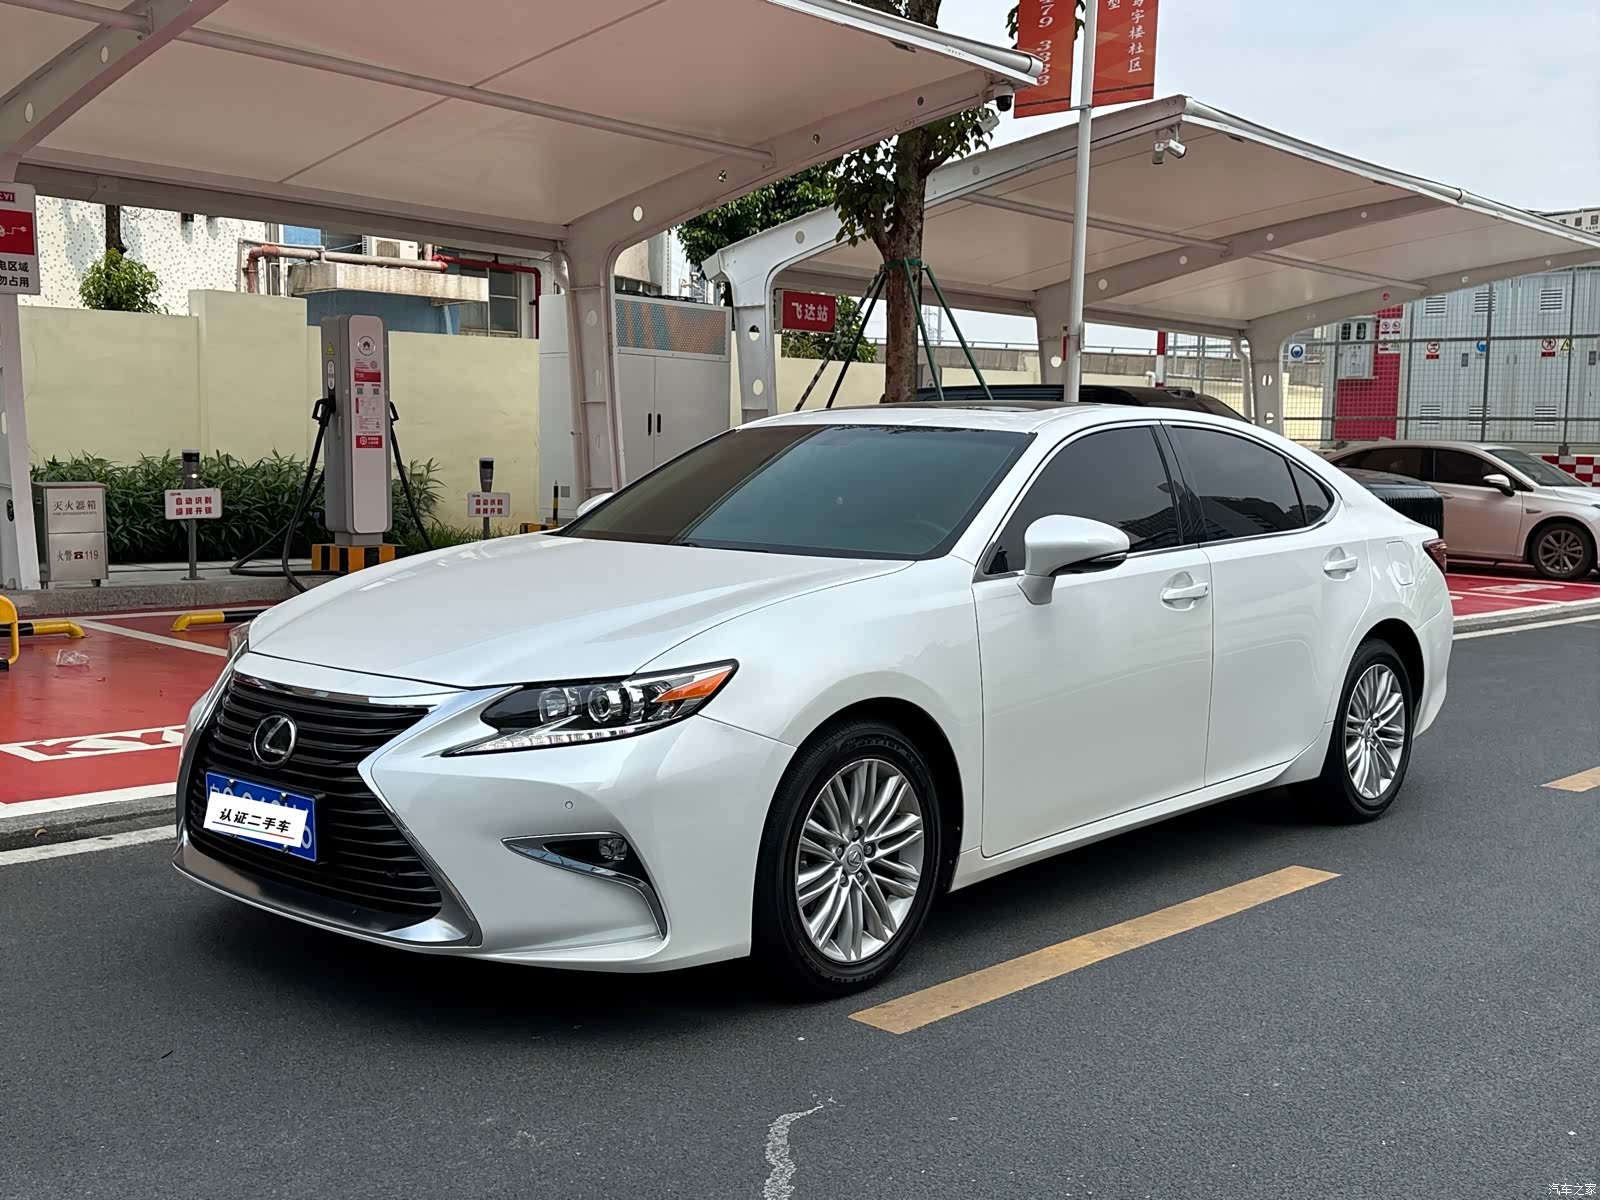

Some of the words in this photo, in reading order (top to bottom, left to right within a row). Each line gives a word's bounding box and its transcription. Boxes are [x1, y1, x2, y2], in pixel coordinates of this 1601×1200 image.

[1038, 0, 1055, 28] 79
[1036, 40, 1053, 87] 3333
[0, 261, 29, 273] 电区域
[791, 301, 829, 322] 飞达站
[53, 499, 97, 511] 灭火器箱
[175, 496, 212, 505] 自动识别
[56, 549, 72, 561] 火警
[85, 549, 99, 560] 119
